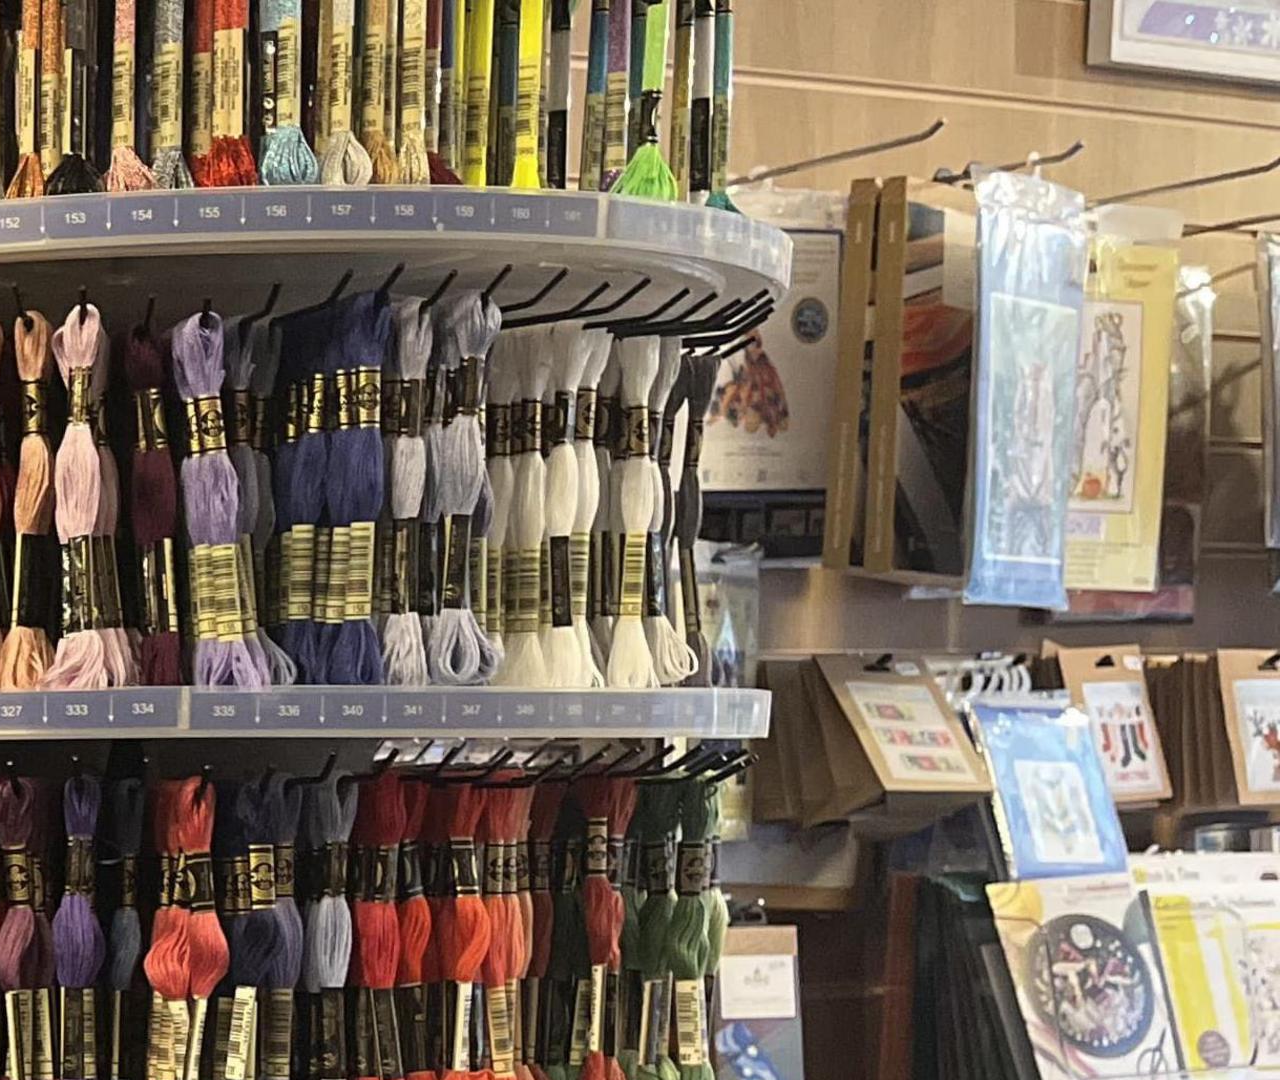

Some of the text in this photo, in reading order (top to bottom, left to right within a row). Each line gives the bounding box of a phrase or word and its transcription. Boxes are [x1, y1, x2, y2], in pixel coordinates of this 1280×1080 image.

[0, 216, 21, 229] 152
[64, 211, 87, 225] 153
[131, 209, 153, 221] 154
[199, 206, 221, 219] 155
[265, 204, 287, 217] 156
[331, 204, 352, 216] 157
[394, 204, 415, 217] 158
[0, 705, 23, 717] 327
[65, 704, 89, 716] 333
[131, 702, 155, 715] 334
[212, 704, 236, 717] 335
[277, 704, 301, 717] 336
[342, 704, 364, 716] 340
[404, 704, 423, 716] 341
[462, 704, 481, 716] 347
